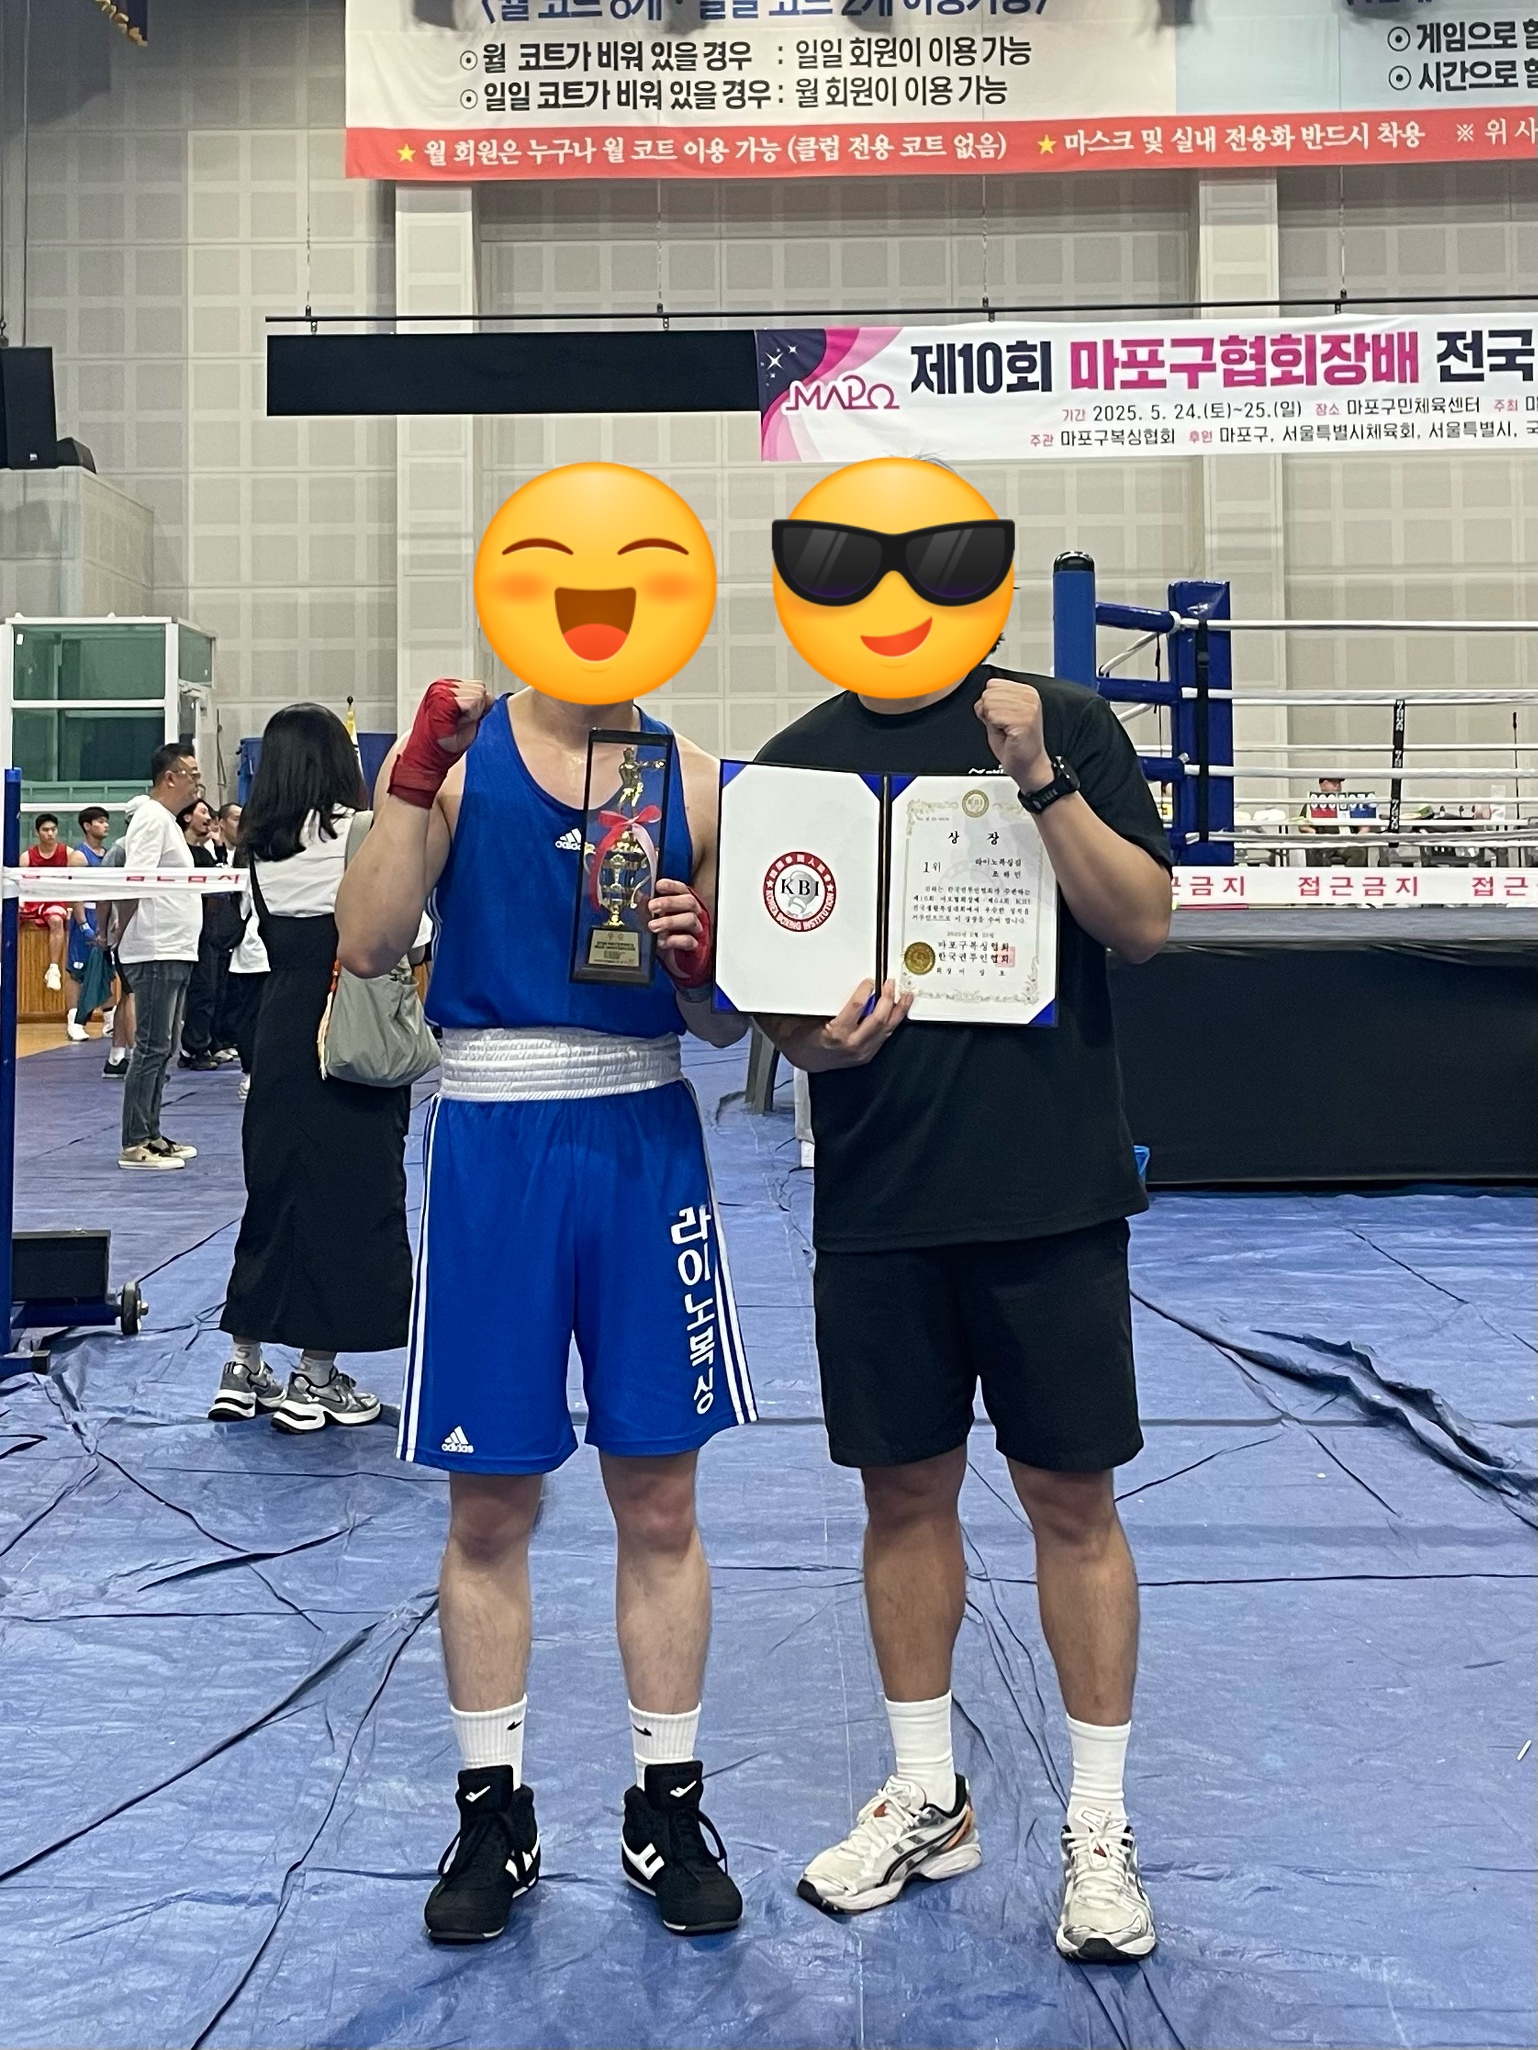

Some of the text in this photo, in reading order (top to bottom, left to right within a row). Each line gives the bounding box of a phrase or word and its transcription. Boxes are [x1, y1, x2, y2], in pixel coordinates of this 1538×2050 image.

[1416, 21, 1517, 53] 게임으로
[483, 43, 505, 73] 월
[519, 41, 591, 71] 코트가
[598, 41, 642, 71] 비워
[651, 42, 698, 71] 있을
[704, 41, 752, 71] 경우
[796, 39, 842, 69] 일일
[850, 37, 920, 67] 회원이
[929, 37, 977, 66] 이용
[983, 36, 1031, 66] 가능
[1419, 60, 1518, 92] 시간으로
[484, 81, 530, 111] 일일
[538, 80, 610, 110] 코트가
[617, 80, 661, 110] 비워
[670, 81, 716, 109] 있을
[723, 80, 771, 109] 경우
[796, 78, 818, 108] 월
[826, 76, 896, 107] 회원이
[905, 76, 952, 106] 이용
[959, 75, 1007, 105] 가능
[424, 140, 446, 166] 월
[454, 139, 522, 166] 회원은
[527, 138, 597, 164] 누구나
[602, 137, 624, 163] 월
[631, 140, 677, 159] 코트
[684, 138, 729, 163] 이용
[736, 137, 782, 163] 가능
[788, 135, 839, 163] (클럽
[848, 134, 894, 160] 전용
[900, 136, 947, 156] 코트
[954, 132, 1006, 159] 없음)
[1065, 130, 1134, 156] 마스크
[1141, 127, 1163, 154] 및
[1171, 126, 1215, 152] 실내
[1225, 124, 1295, 151] 전용화
[1301, 122, 1368, 149] 반드시
[1378, 121, 1425, 148] 착용
[1485, 118, 1506, 144] 위
[911, 329, 1535, 394] 제10회 마포구협회장배 전국
[785, 374, 900, 410] MAPO
[1063, 409, 1085, 421] 기간
[1093, 405, 1142, 421] 2025.
[1152, 405, 1166, 420] 5.
[1316, 403, 1339, 416] 장소
[1348, 397, 1479, 415] 마포구민체육센터
[1494, 399, 1517, 412] 주최
[1031, 434, 1054, 447] 주관
[1061, 429, 1174, 446] 마포구복싱협회
[1189, 431, 1212, 443] 후원
[1220, 427, 1273, 442] 마포구,
[1283, 423, 1420, 441] 서울특별시체육회,
[1429, 421, 1517, 438] 서울특별시,
[781, 878, 820, 897] KBI
[1299, 876, 1417, 896] 접근금지
[1471, 875, 1538, 897] 접근
[670, 1204, 716, 1416] 라이노복싱
[440, 1442, 475, 1454] adidas
